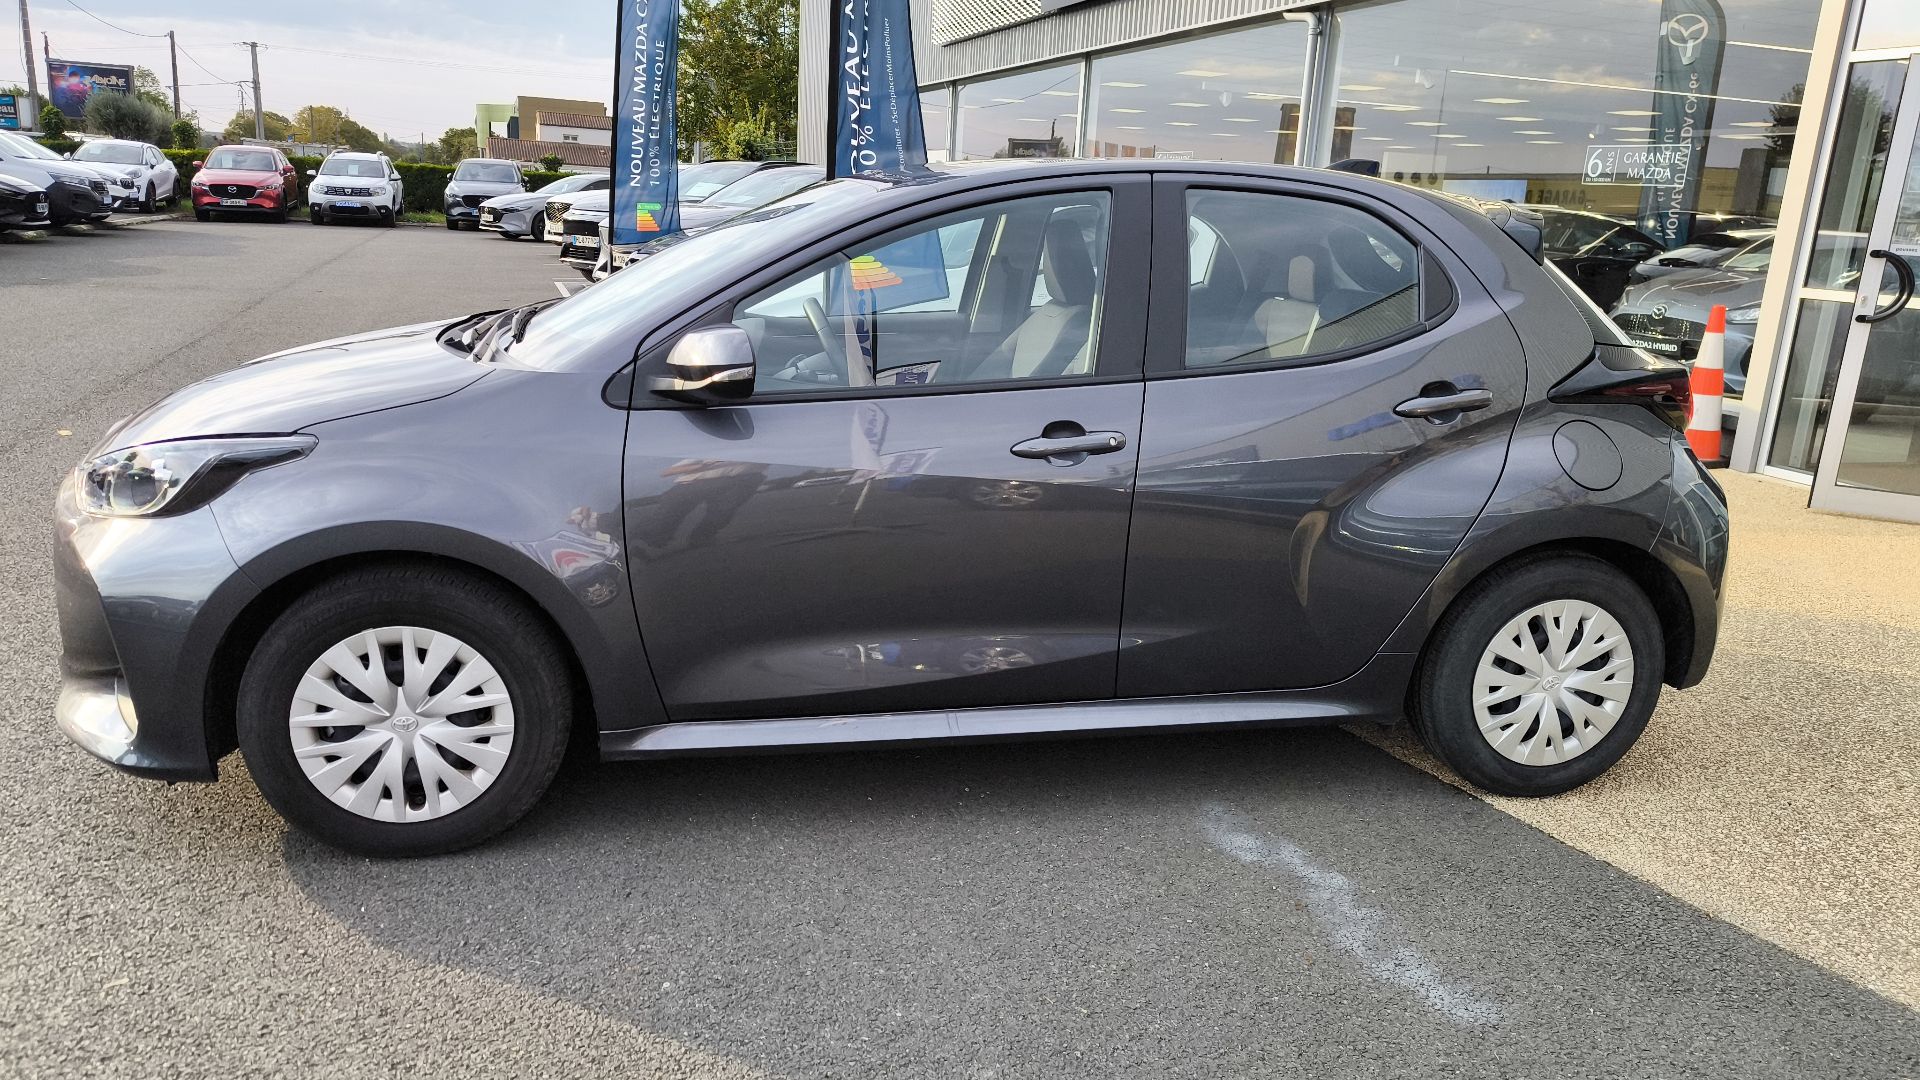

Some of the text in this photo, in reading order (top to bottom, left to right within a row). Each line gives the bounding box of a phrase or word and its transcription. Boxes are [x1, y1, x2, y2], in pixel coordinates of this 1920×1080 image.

[633, 23, 648, 94] MAZDA
[648, 39, 665, 139] ÉLECTRIQUE
[630, 99, 646, 187] NOUVEAU
[1623, 151, 1682, 164] GARANTIE
[649, 146, 661, 187] 100%
[1587, 148, 1603, 178] 6
[1605, 151, 1615, 175] ANS
[1626, 167, 1671, 179] MAZDA
[1653, 342, 1678, 351] HYBRID
